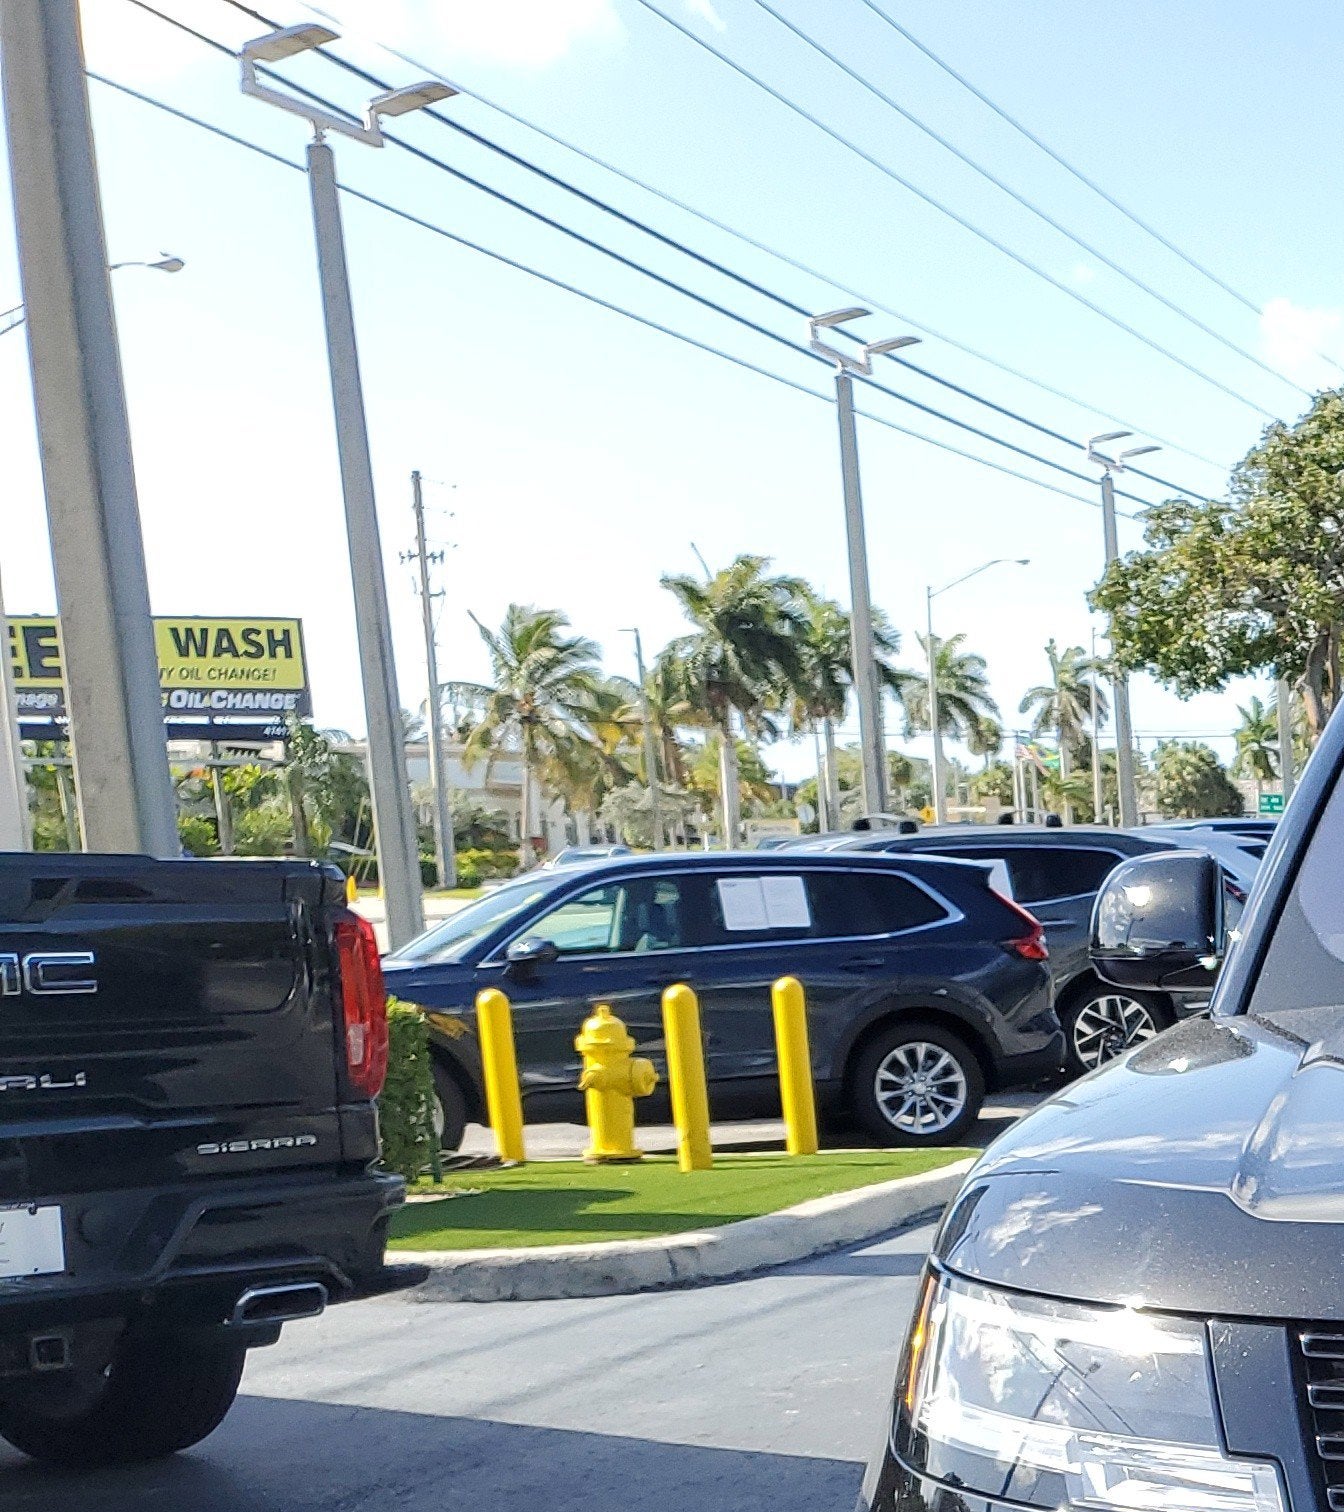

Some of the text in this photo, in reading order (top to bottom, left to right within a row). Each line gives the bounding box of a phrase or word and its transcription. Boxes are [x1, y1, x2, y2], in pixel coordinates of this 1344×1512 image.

[169, 627, 293, 658] WASH
[169, 689, 297, 710] OIL CHANGE
[196, 1134, 317, 1155] SIERRA
